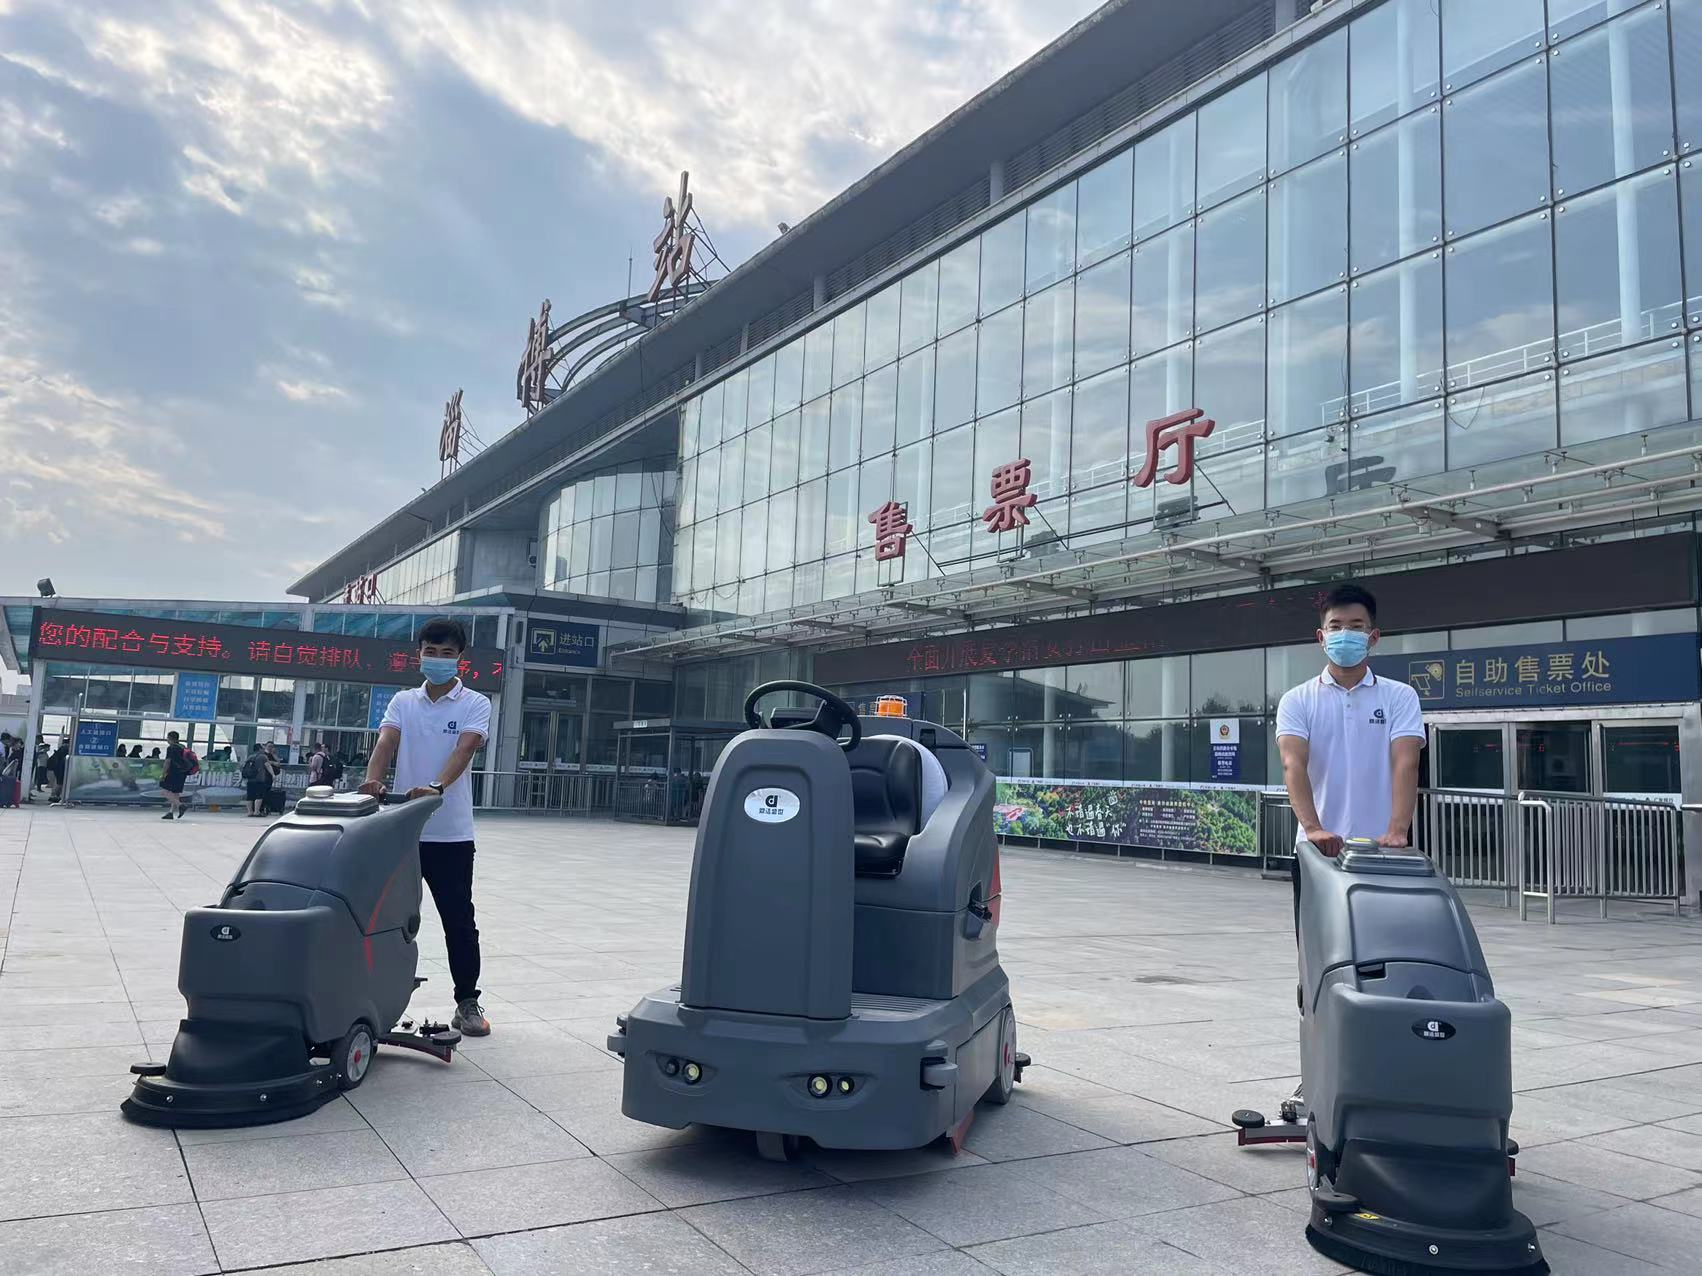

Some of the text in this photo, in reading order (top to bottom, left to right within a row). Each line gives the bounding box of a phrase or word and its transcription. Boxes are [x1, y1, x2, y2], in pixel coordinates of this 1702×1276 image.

[868, 407, 1216, 563] 售票厅
[559, 633, 594, 647] 进站口
[1455, 651, 1611, 686] 自助售票处
[1455, 681, 1612, 698] Selfservice Ticket Office
